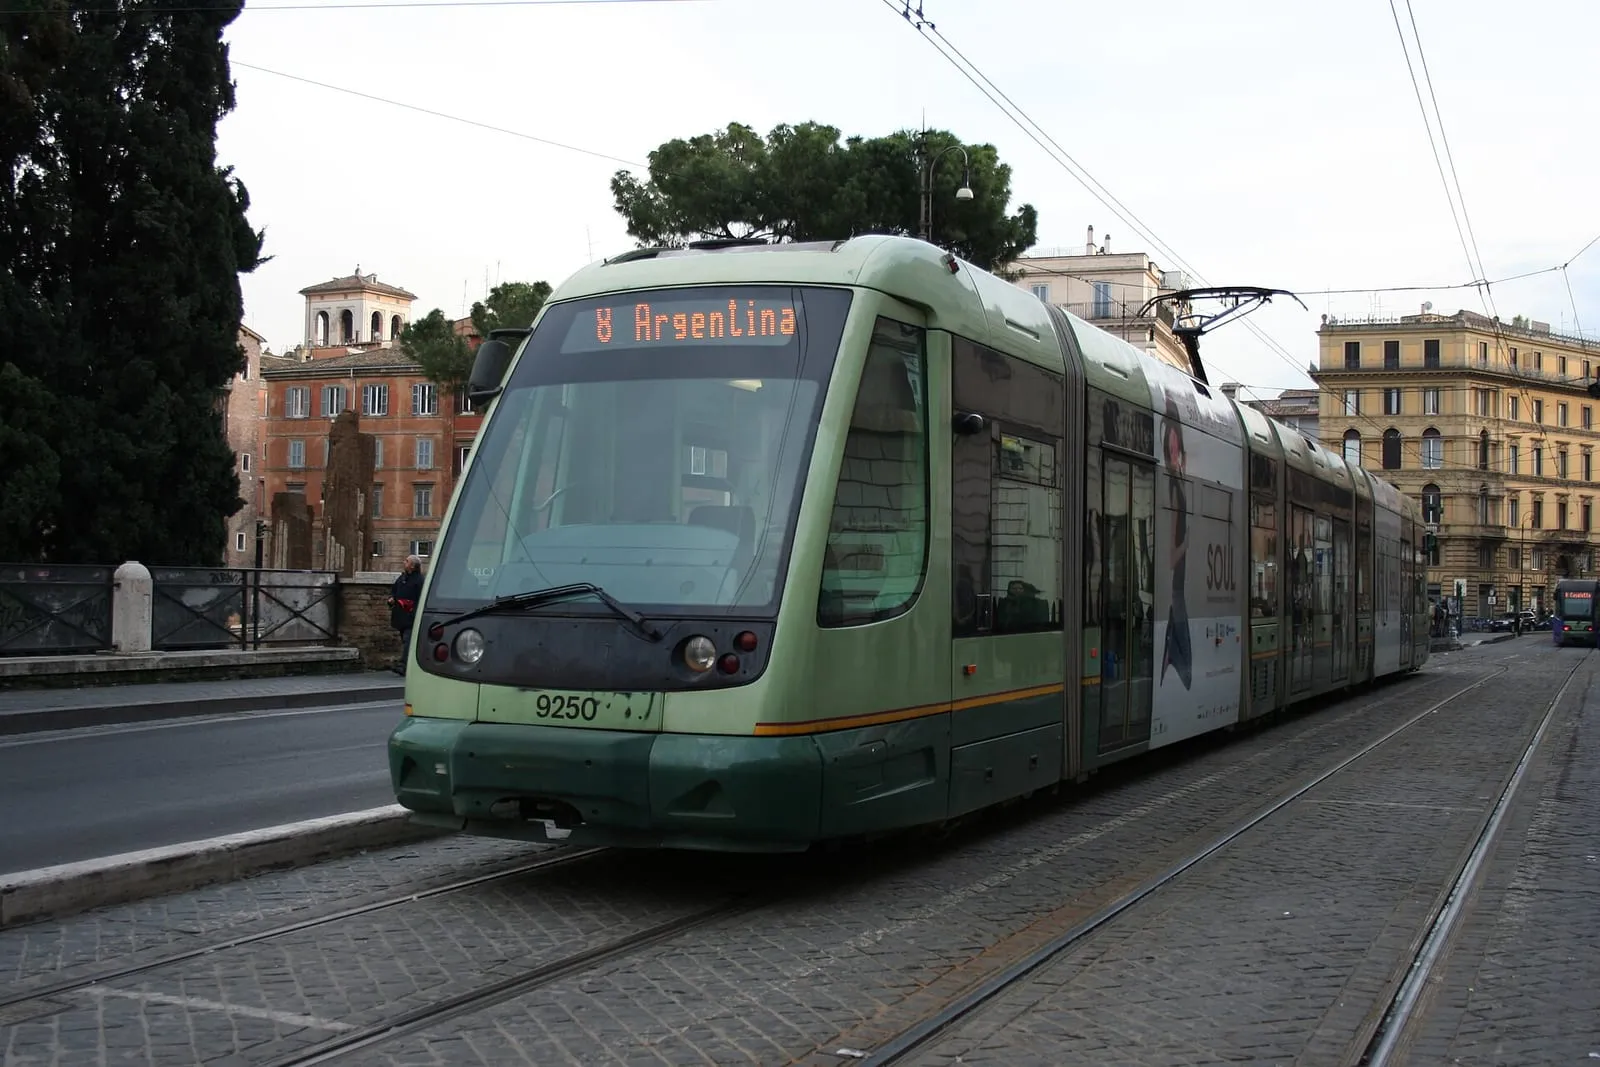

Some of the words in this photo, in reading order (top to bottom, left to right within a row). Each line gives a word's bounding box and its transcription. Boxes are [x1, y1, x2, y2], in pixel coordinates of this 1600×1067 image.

[595, 307, 613, 343] 8
[634, 299, 796, 342] Argentina
[1207, 543, 1236, 591] SOUL
[536, 694, 598, 721] 9250
